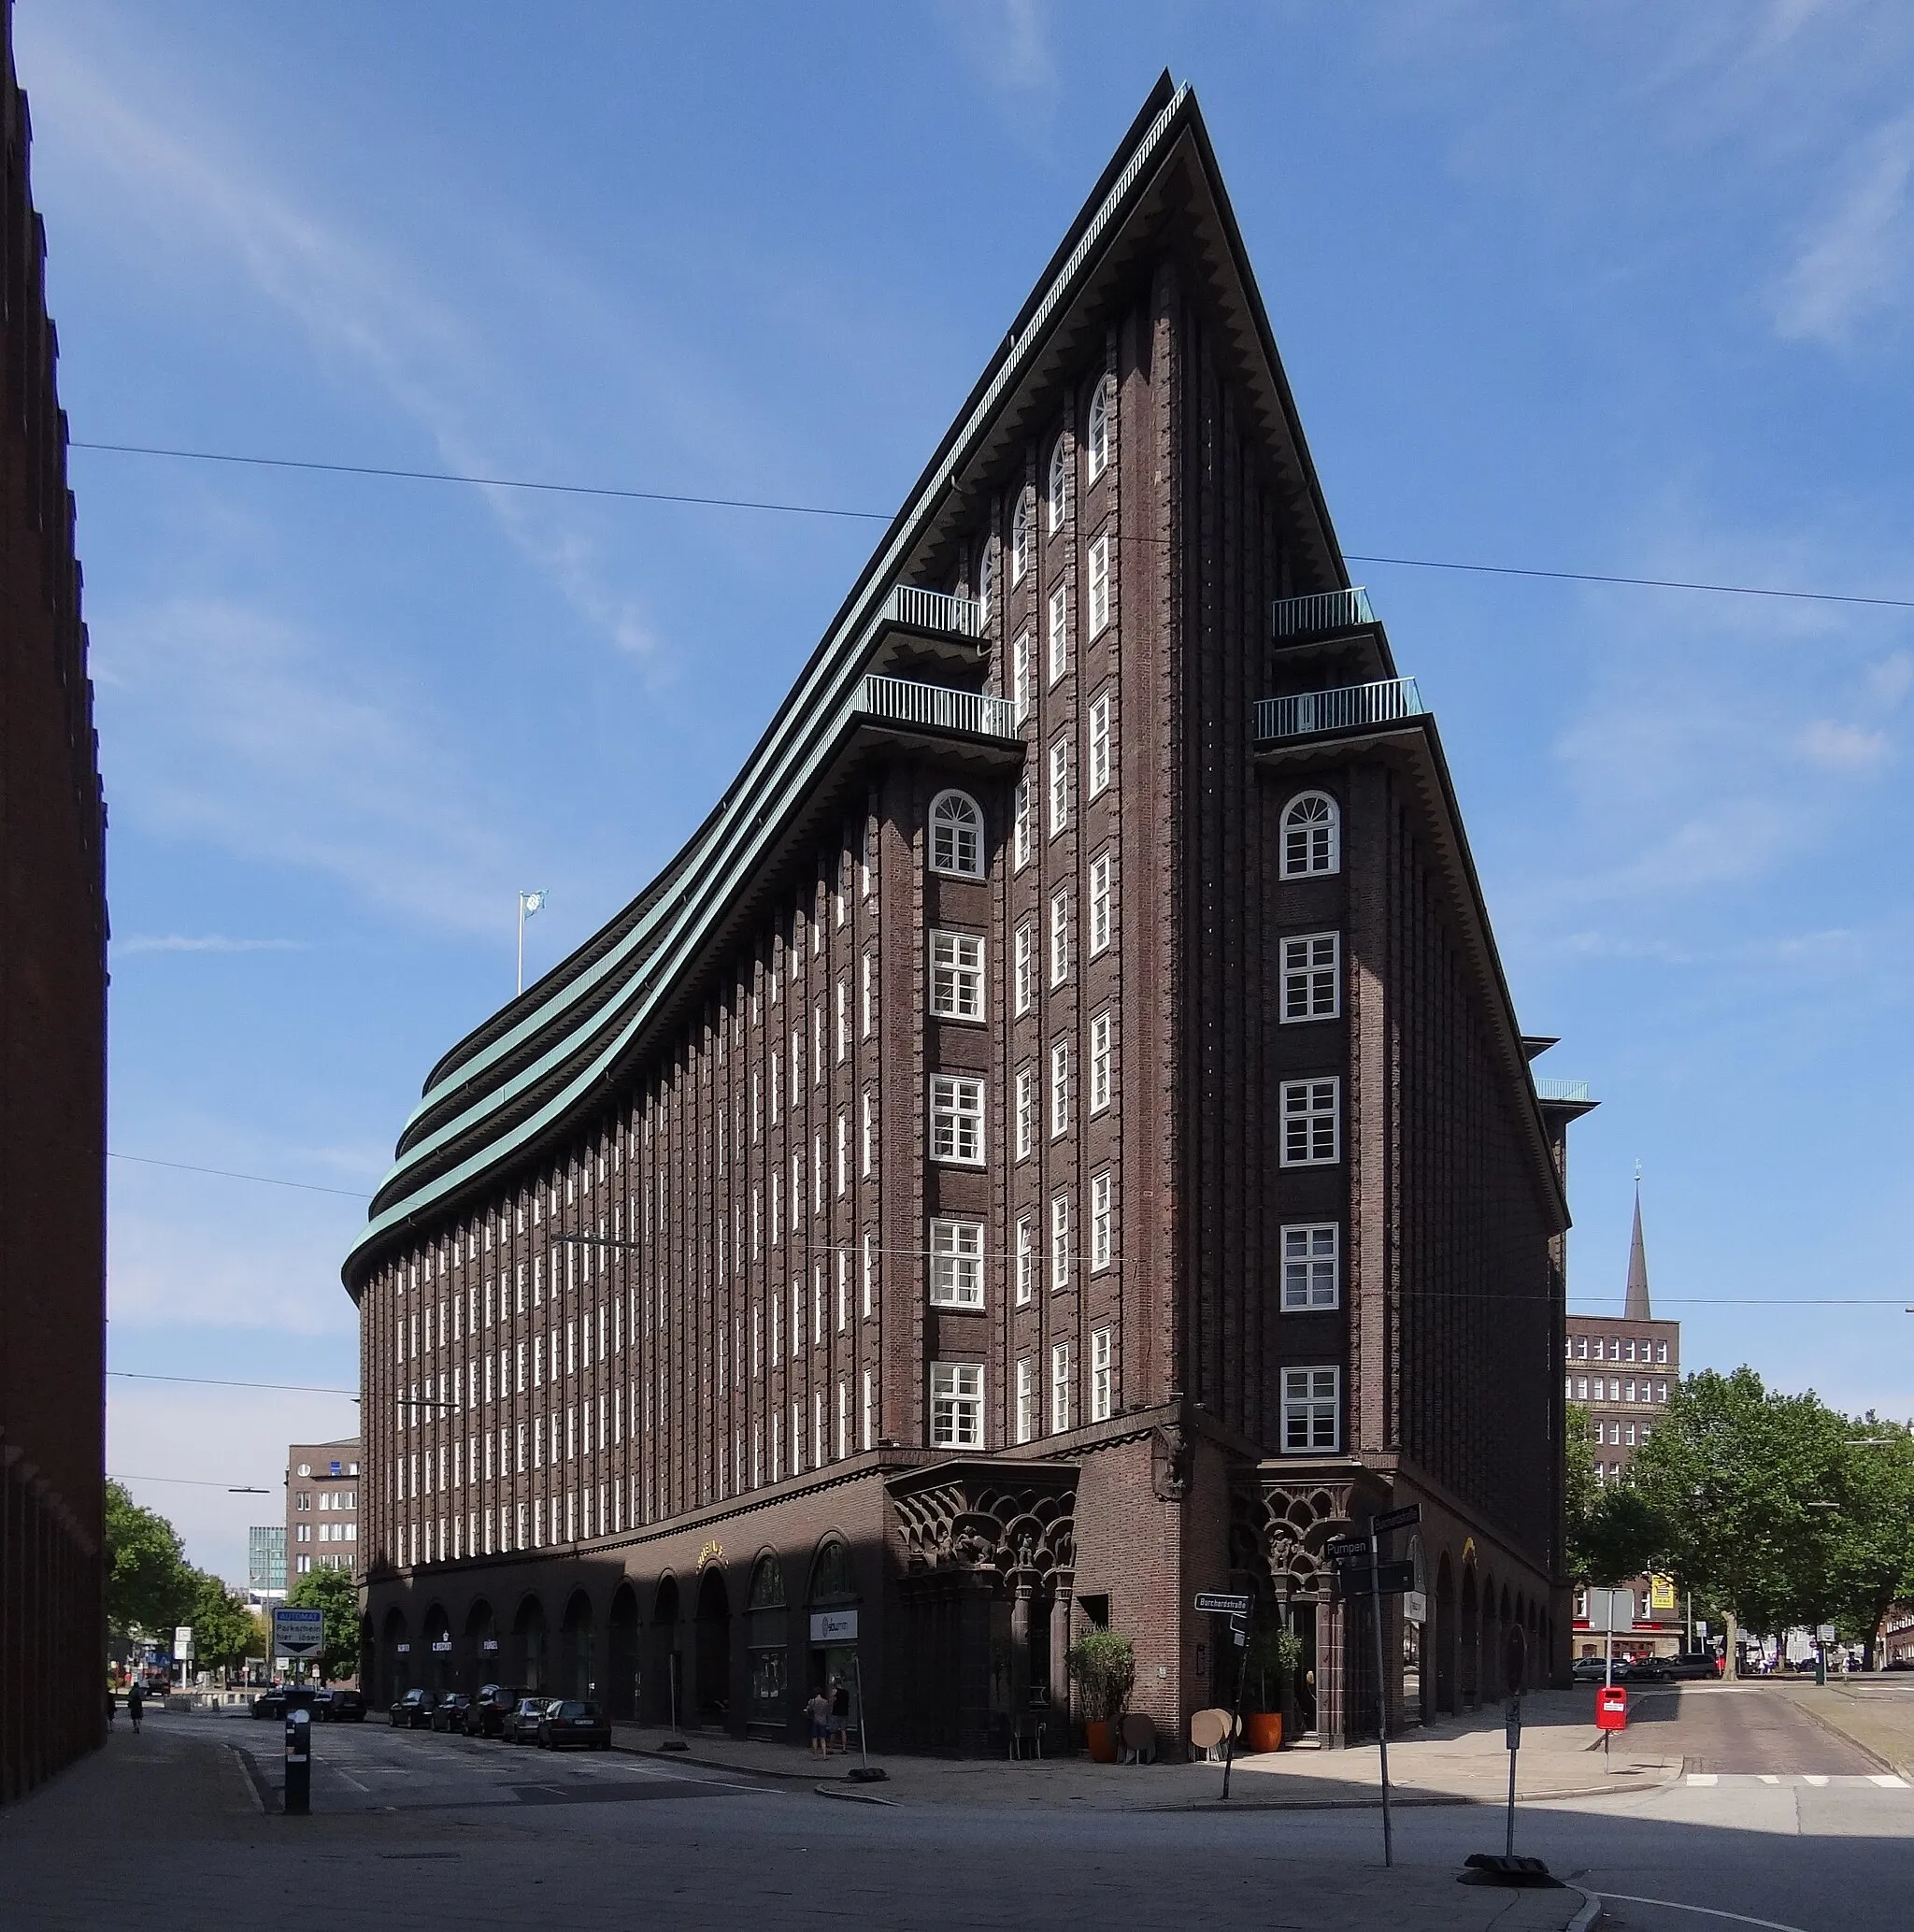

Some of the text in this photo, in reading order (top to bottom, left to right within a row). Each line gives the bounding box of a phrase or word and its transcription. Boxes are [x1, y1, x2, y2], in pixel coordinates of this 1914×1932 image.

[1327, 1542, 1366, 1555] Pumpen
[1200, 1597, 1246, 1609] Burchardstraße
[276, 1624, 321, 1632] Parkschein
